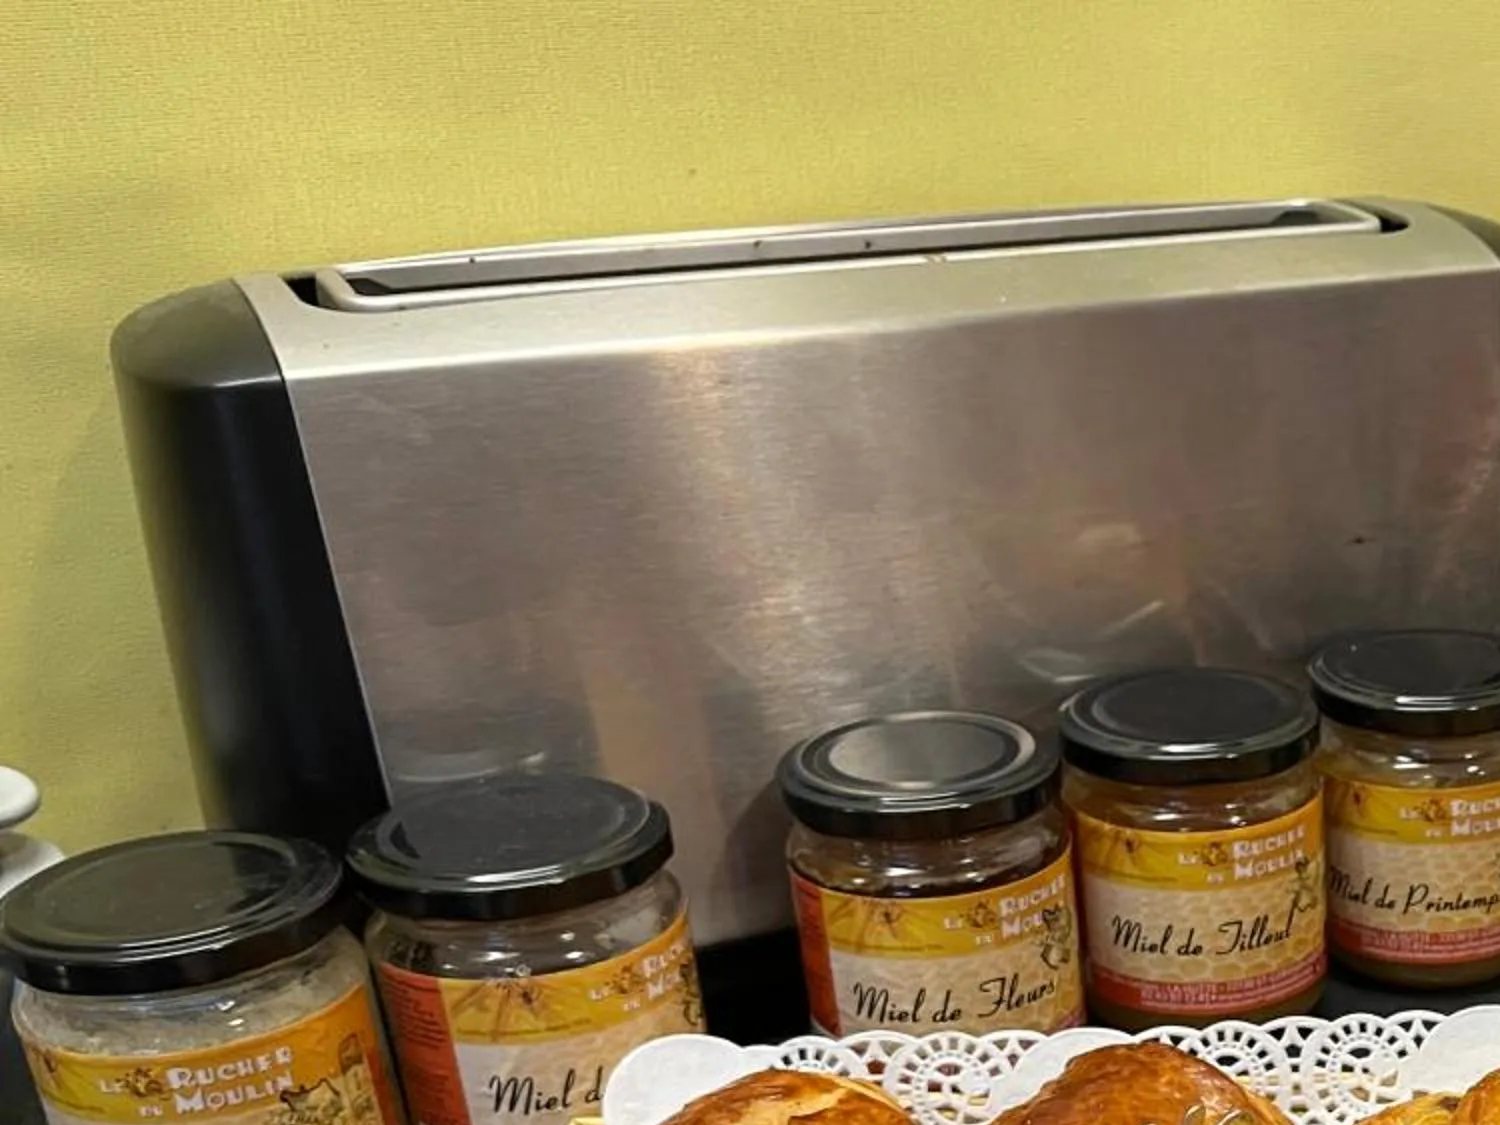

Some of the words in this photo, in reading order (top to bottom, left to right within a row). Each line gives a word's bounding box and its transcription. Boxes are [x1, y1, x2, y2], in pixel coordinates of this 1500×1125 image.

[1329, 865, 1374, 905] Miel
[1374, 884, 1396, 910] de
[1111, 914, 1173, 955] Miel
[1177, 927, 1204, 957] de
[1215, 895, 1297, 955] Tilleul
[853, 981, 926, 1024] Miel
[931, 989, 963, 1023] de
[977, 972, 1055, 1017] Fleurs
[166, 1045, 293, 1089] RUCHER
[489, 1067, 575, 1115] Miel
[584, 1064, 604, 1104] d
[173, 1070, 294, 1115] MOULIN
